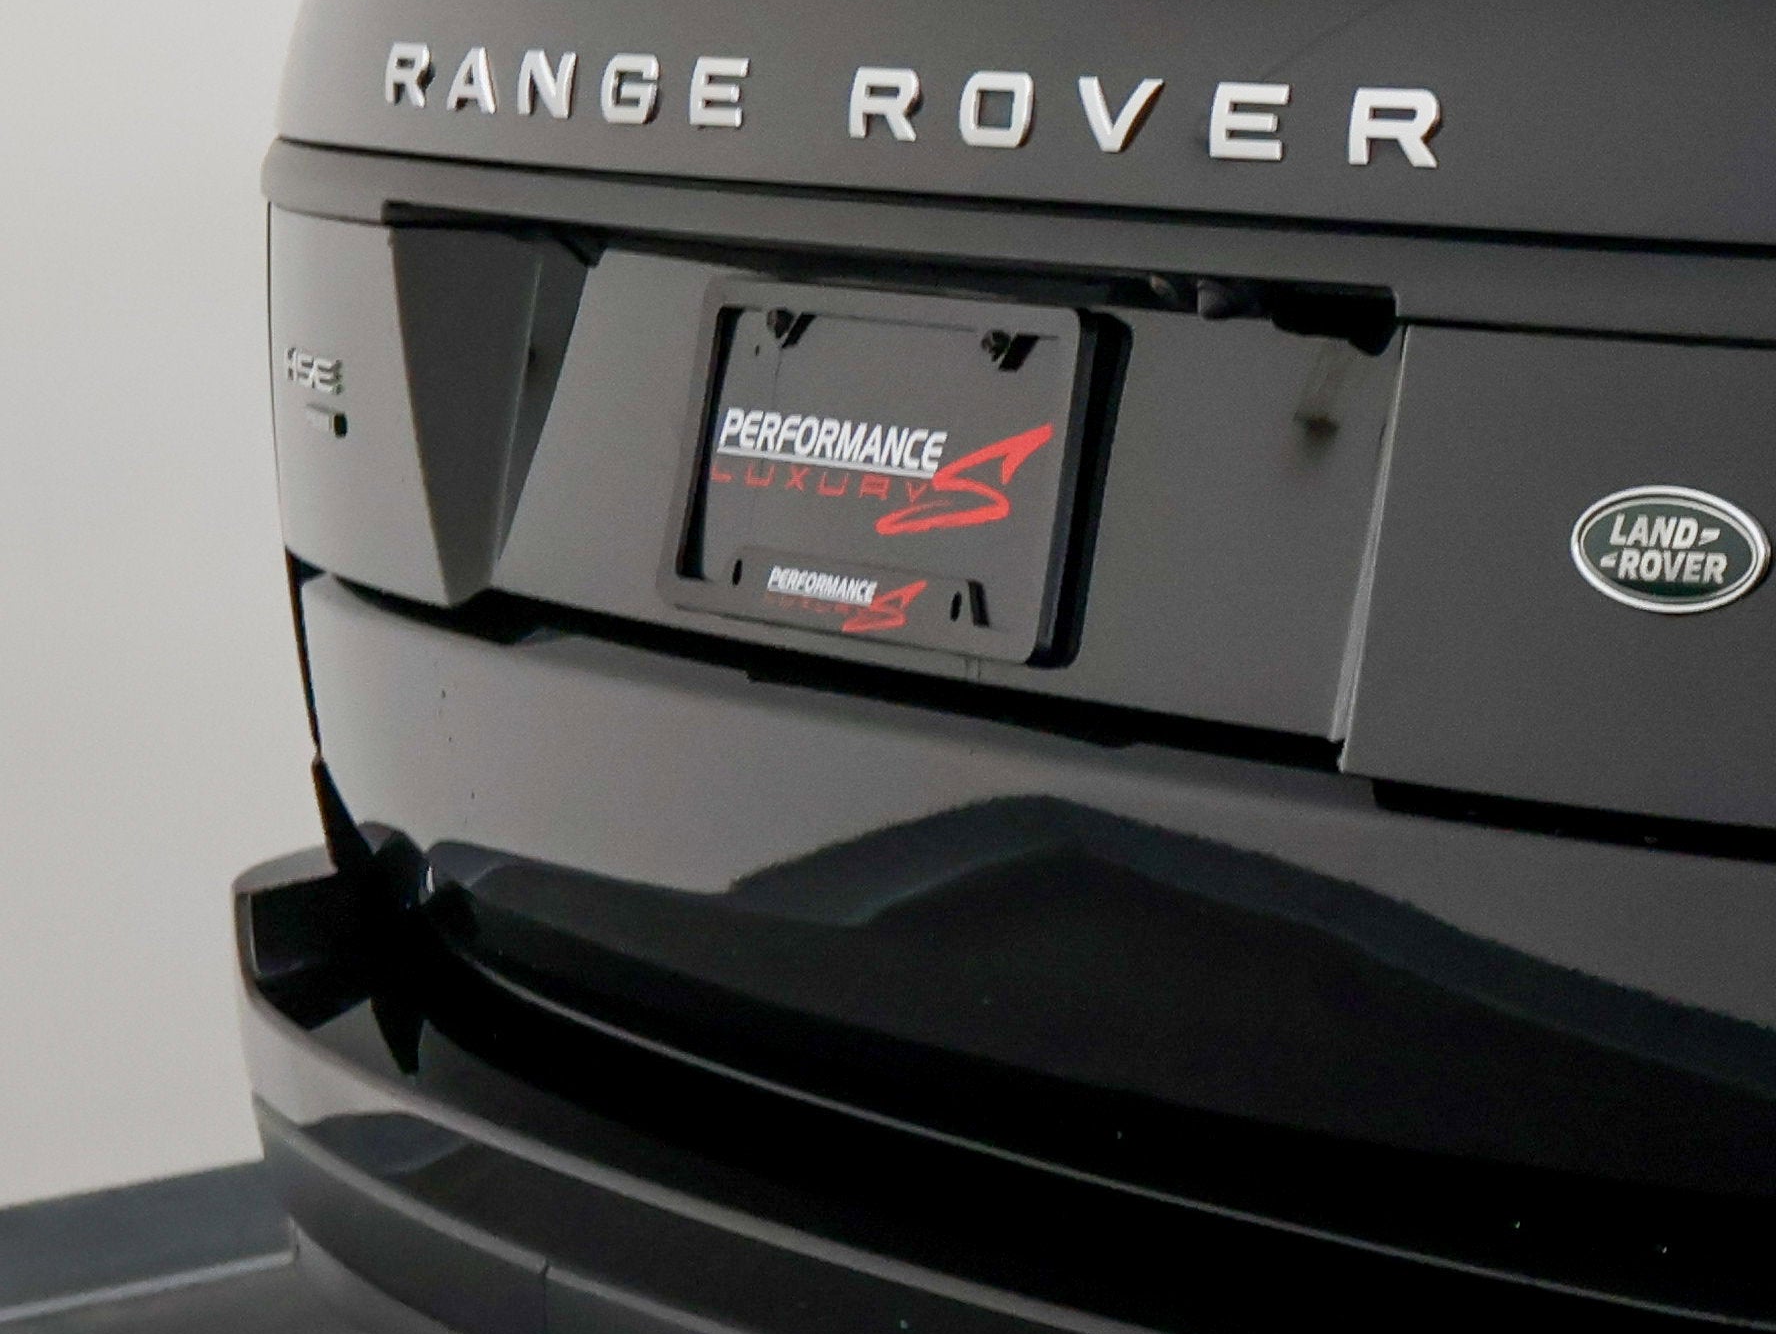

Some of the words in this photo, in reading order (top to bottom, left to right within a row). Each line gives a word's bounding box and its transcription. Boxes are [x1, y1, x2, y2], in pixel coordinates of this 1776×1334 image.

[385, 40, 753, 130] RANGE
[847, 66, 1442, 170] ROVER
[718, 407, 949, 475] PERFORMANCE
[711, 463, 930, 503] LUXURY
[1609, 512, 1699, 550] LAND
[767, 565, 879, 605] PERFORMANCE
[1617, 547, 1728, 584] ROVER
